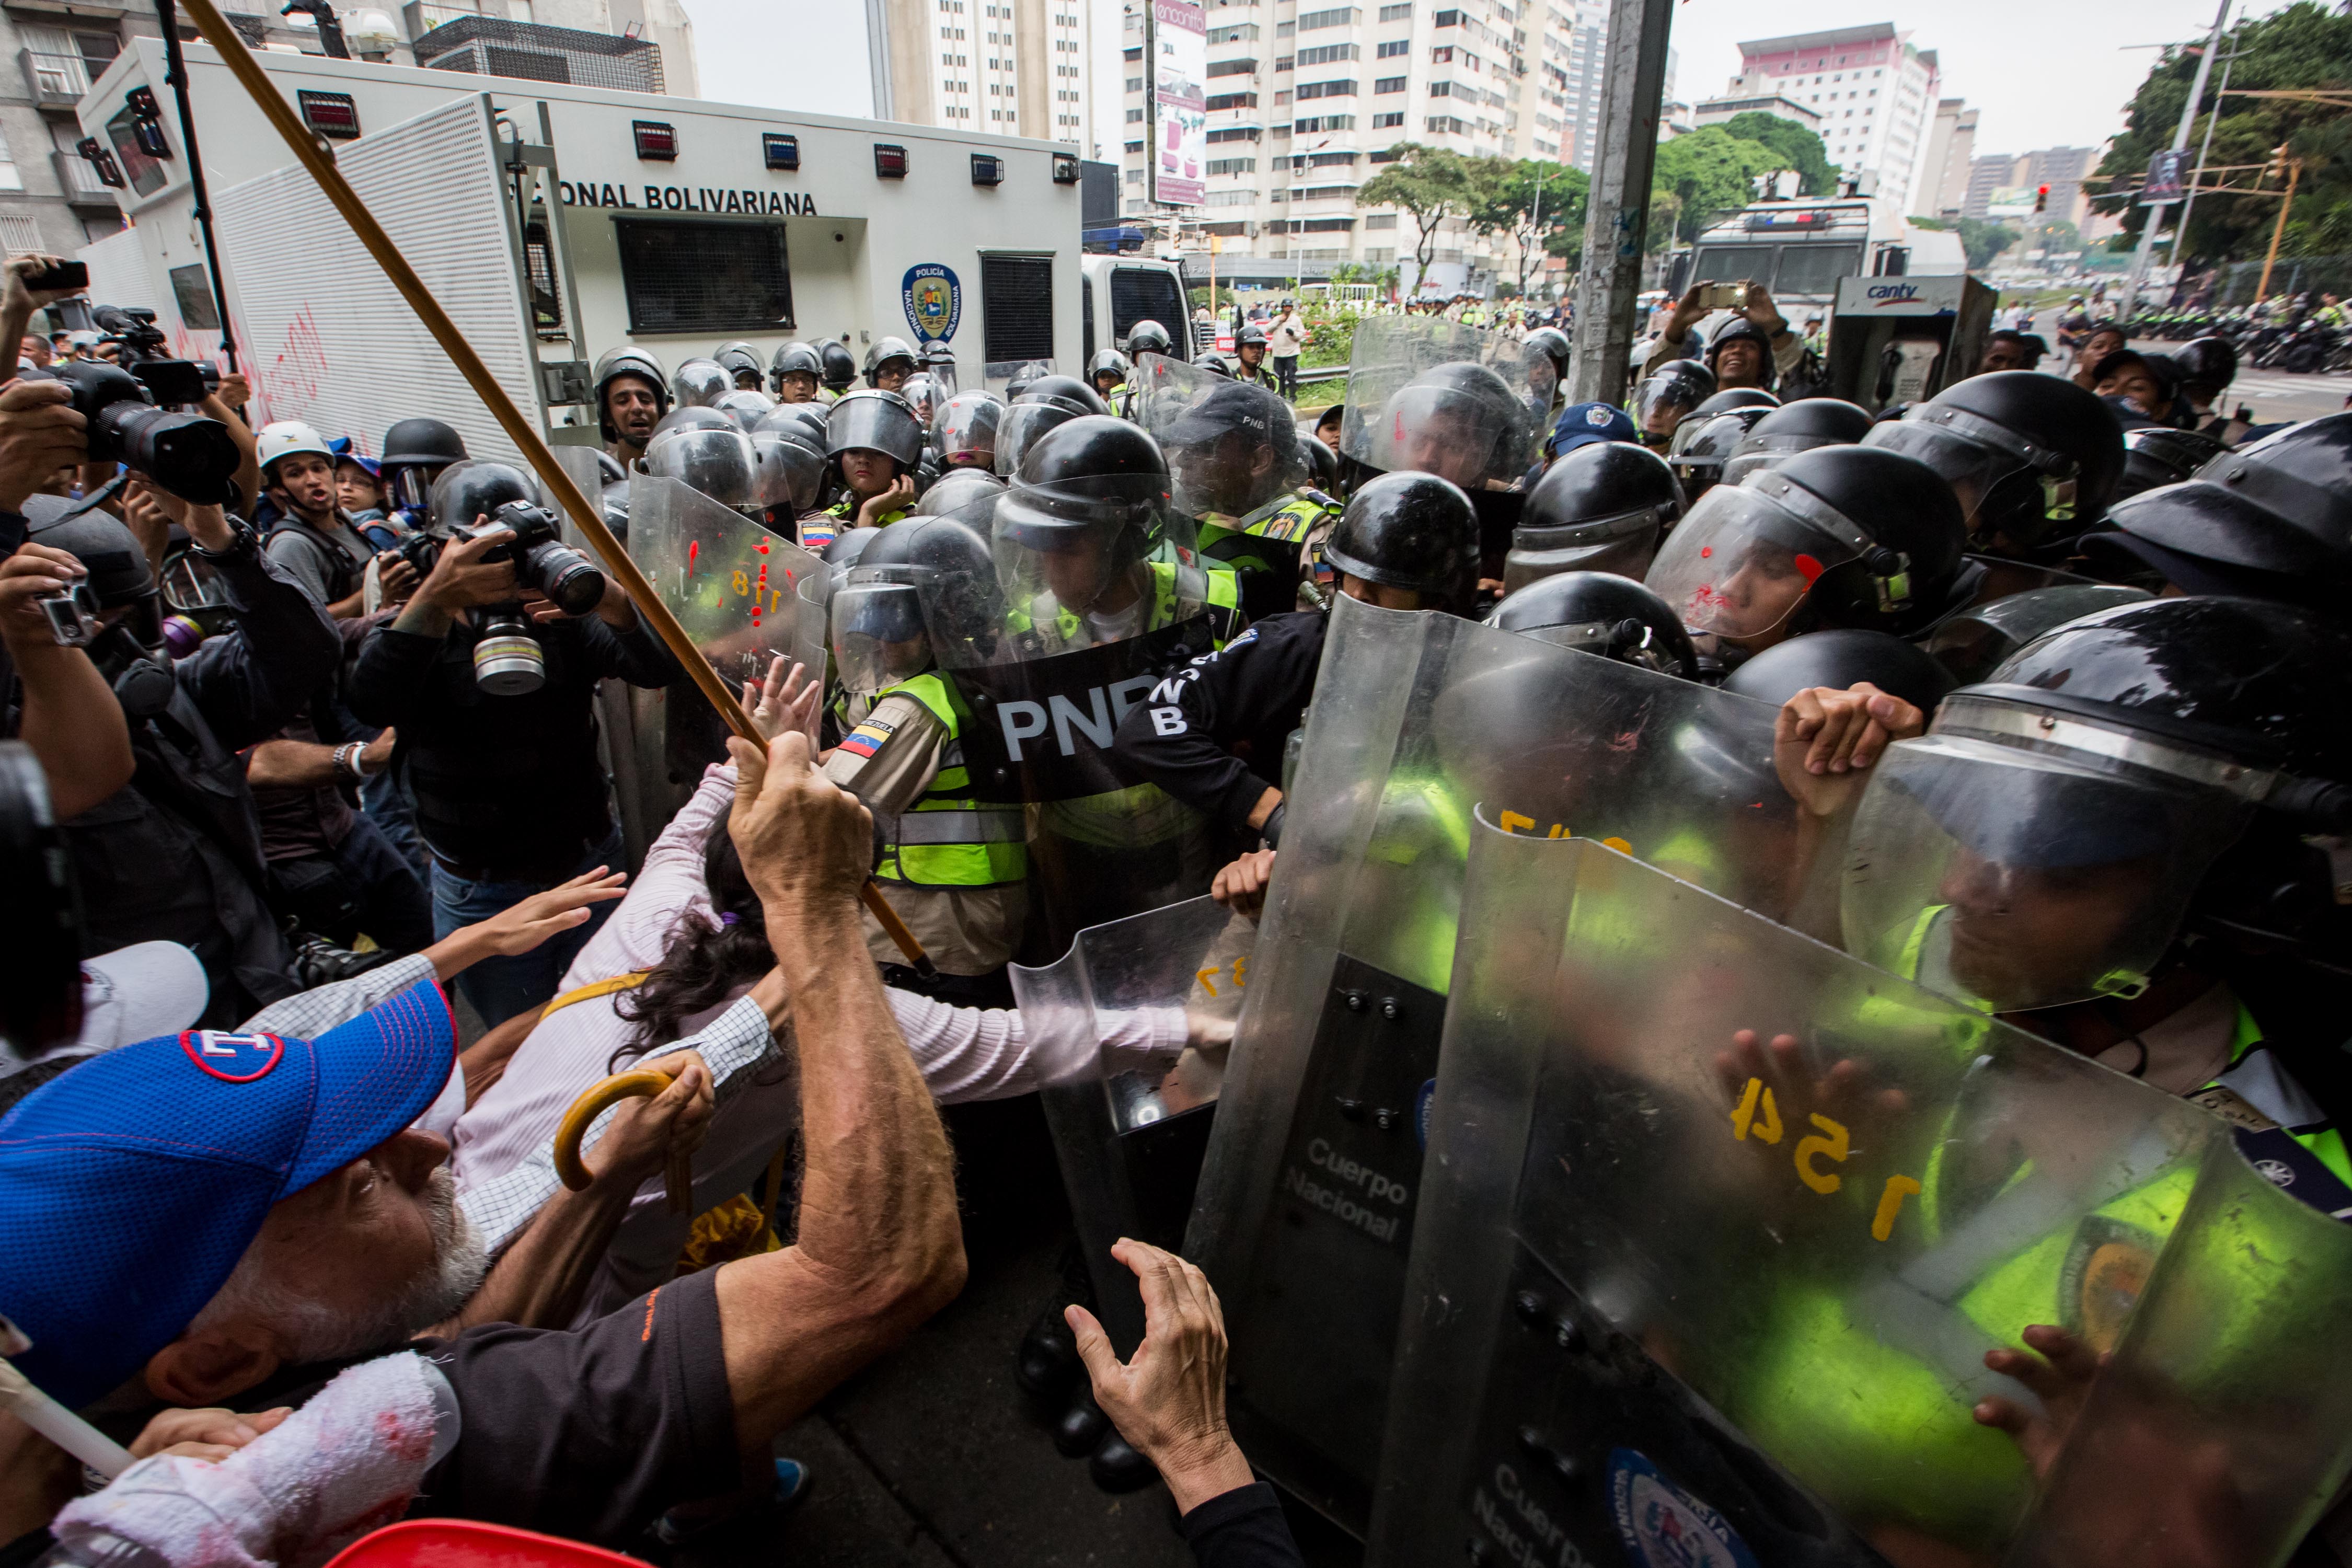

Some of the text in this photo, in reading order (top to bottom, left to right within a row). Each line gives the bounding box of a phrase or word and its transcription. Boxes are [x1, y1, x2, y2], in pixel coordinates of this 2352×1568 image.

[644, 186, 817, 216] BOLIVARIANA
[916, 267, 944, 278] POLICÍA
[904, 290, 922, 337] NACIONAL
[945, 285, 959, 337] BOLIVARIANA
[1242, 416, 1265, 429] PNB
[1308, 1137, 1407, 1204] Cuerpo
[1286, 1166, 1400, 1242] Nacional
[1495, 1463, 1595, 1568] Cuerp
